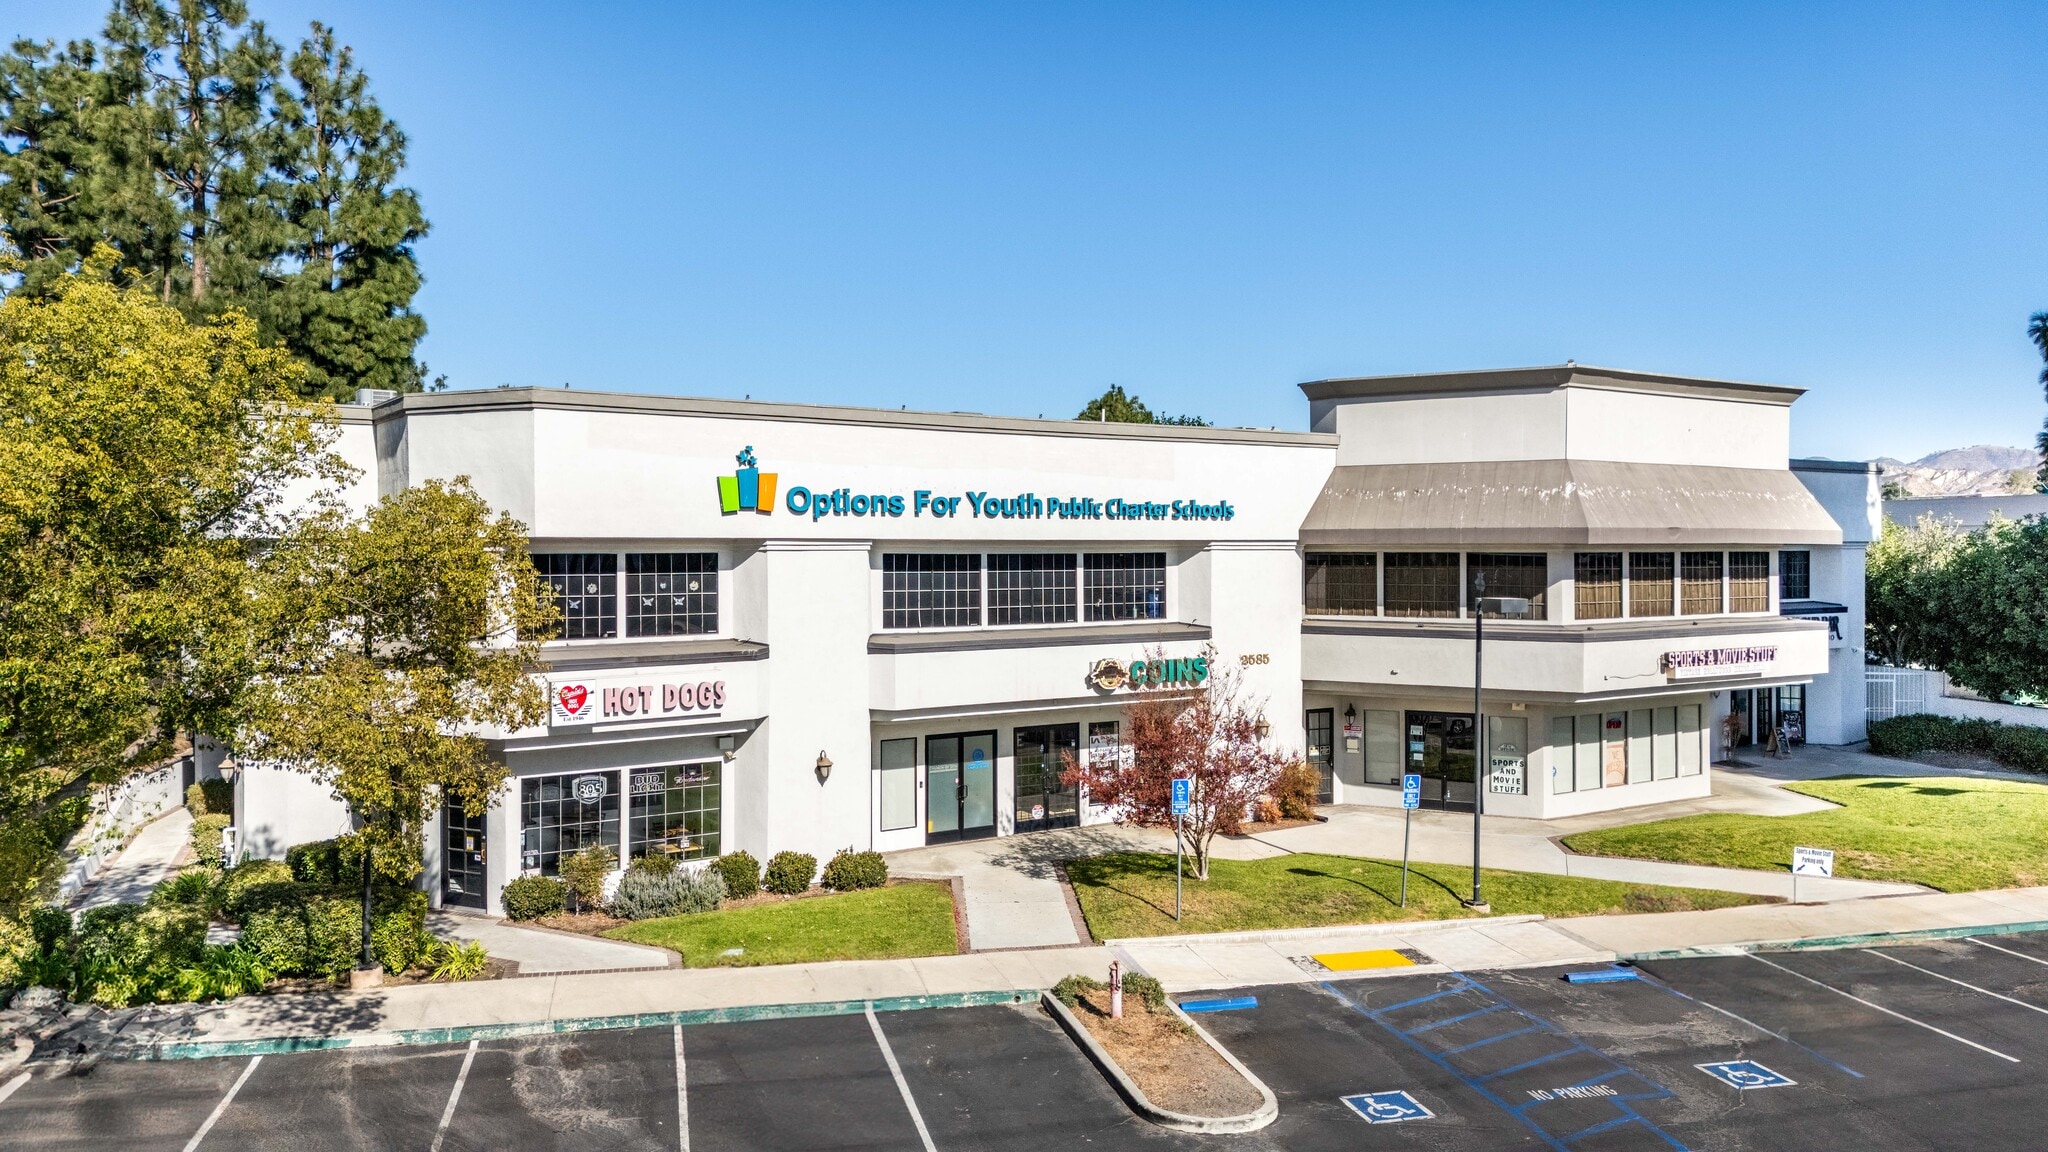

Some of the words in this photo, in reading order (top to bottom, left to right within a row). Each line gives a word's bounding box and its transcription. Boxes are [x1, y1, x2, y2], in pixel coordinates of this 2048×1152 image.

[786, 486, 906, 521] Options
[914, 490, 961, 517] For
[966, 491, 1043, 519] Youth
[1047, 497, 1103, 519] Public
[1106, 498, 1171, 520] Charter
[1172, 499, 1235, 521] Schools
[1240, 653, 1270, 666] 2585
[1669, 651, 1706, 669] SPORTS
[1708, 650, 1715, 665] &
[1717, 648, 1747, 665] MOVIE
[1749, 645, 1778, 663] STUFF
[1129, 657, 1209, 686] COINS
[603, 686, 654, 716] HOT
[662, 680, 727, 712] DOGS
[1492, 759, 1525, 768] SPORTS
[634, 775, 660, 786] BUD
[1493, 775, 1521, 785] MOVIE
[579, 782, 603, 798] 805
[630, 782, 664, 794] LIGHT
[1493, 785, 1521, 794] STUFF
[1526, 1089, 1554, 1101] NO
[1552, 1084, 1618, 1100] PARKING
